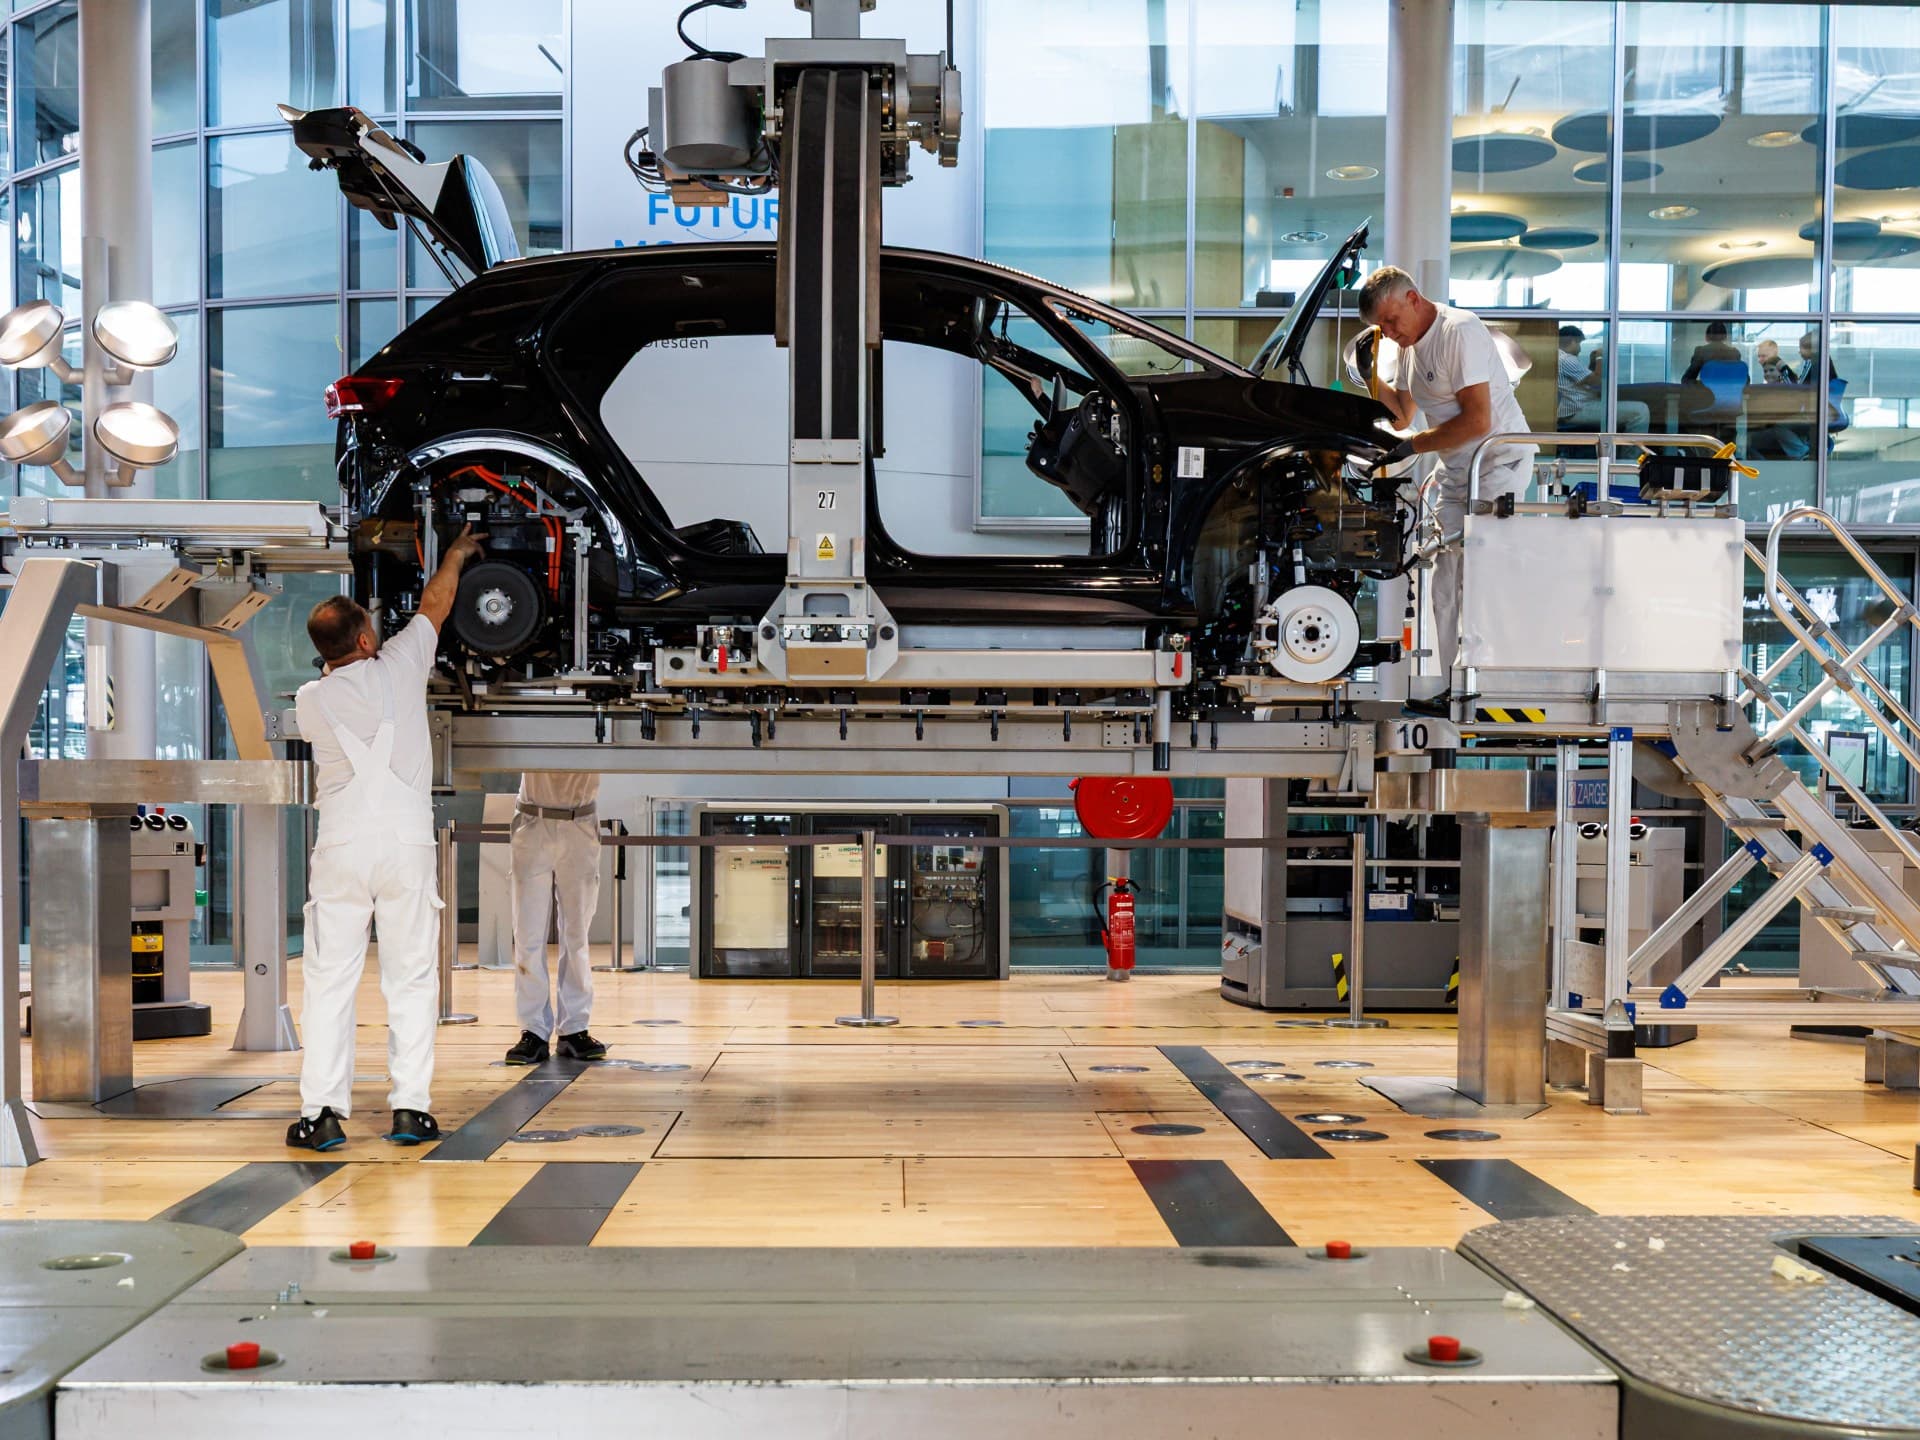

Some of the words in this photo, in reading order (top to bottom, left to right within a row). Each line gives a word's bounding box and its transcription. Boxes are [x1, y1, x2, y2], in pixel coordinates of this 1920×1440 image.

[648, 194, 779, 230] FUTUR
[818, 491, 835, 509] 27
[1397, 723, 1428, 749] 10
[1577, 783, 1608, 805] ZARGE
